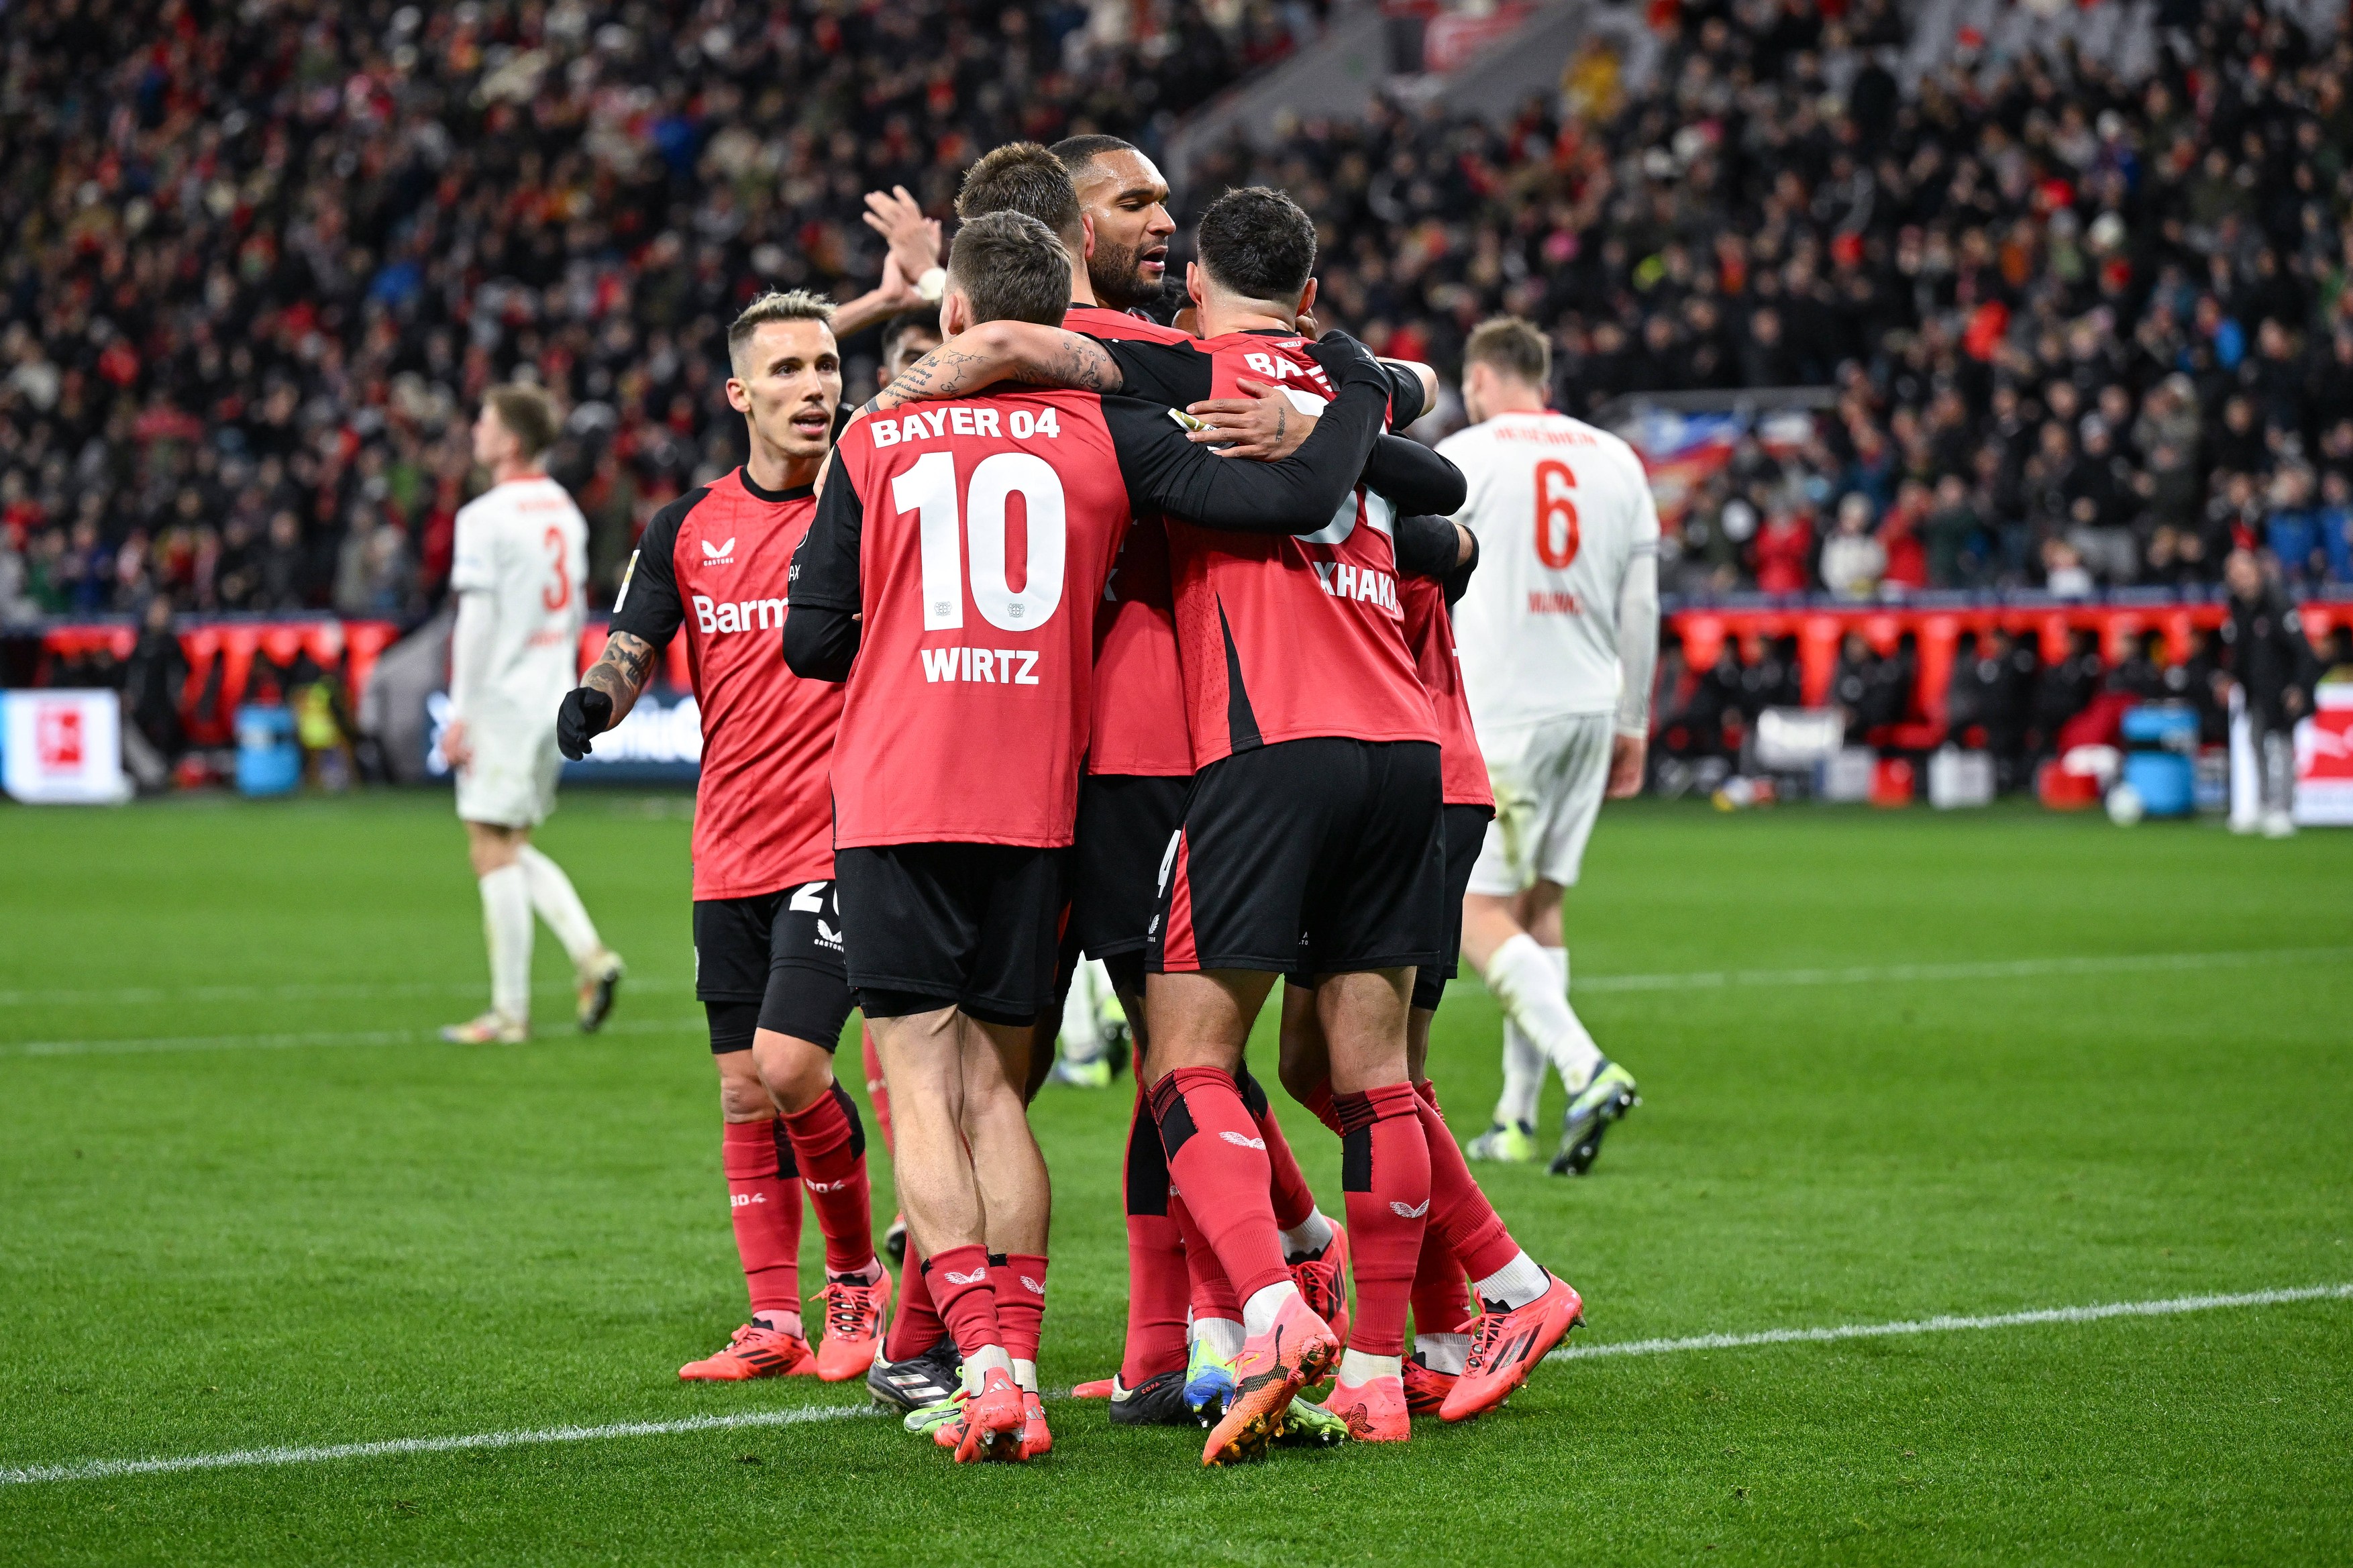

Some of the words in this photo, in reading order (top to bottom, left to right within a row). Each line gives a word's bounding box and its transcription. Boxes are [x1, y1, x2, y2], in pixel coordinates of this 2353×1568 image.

[870, 407, 1002, 449] BAYER
[1008, 407, 1061, 440] 04
[1533, 458, 1580, 571] 6
[890, 451, 1067, 633] 10
[542, 525, 570, 612] 3
[1312, 561, 1399, 615] XHAKA
[692, 594, 789, 634] Barm
[921, 647, 1039, 685] WIRTZ
[789, 881, 839, 917] 2
[1141, 1381, 1160, 1394] COPA
